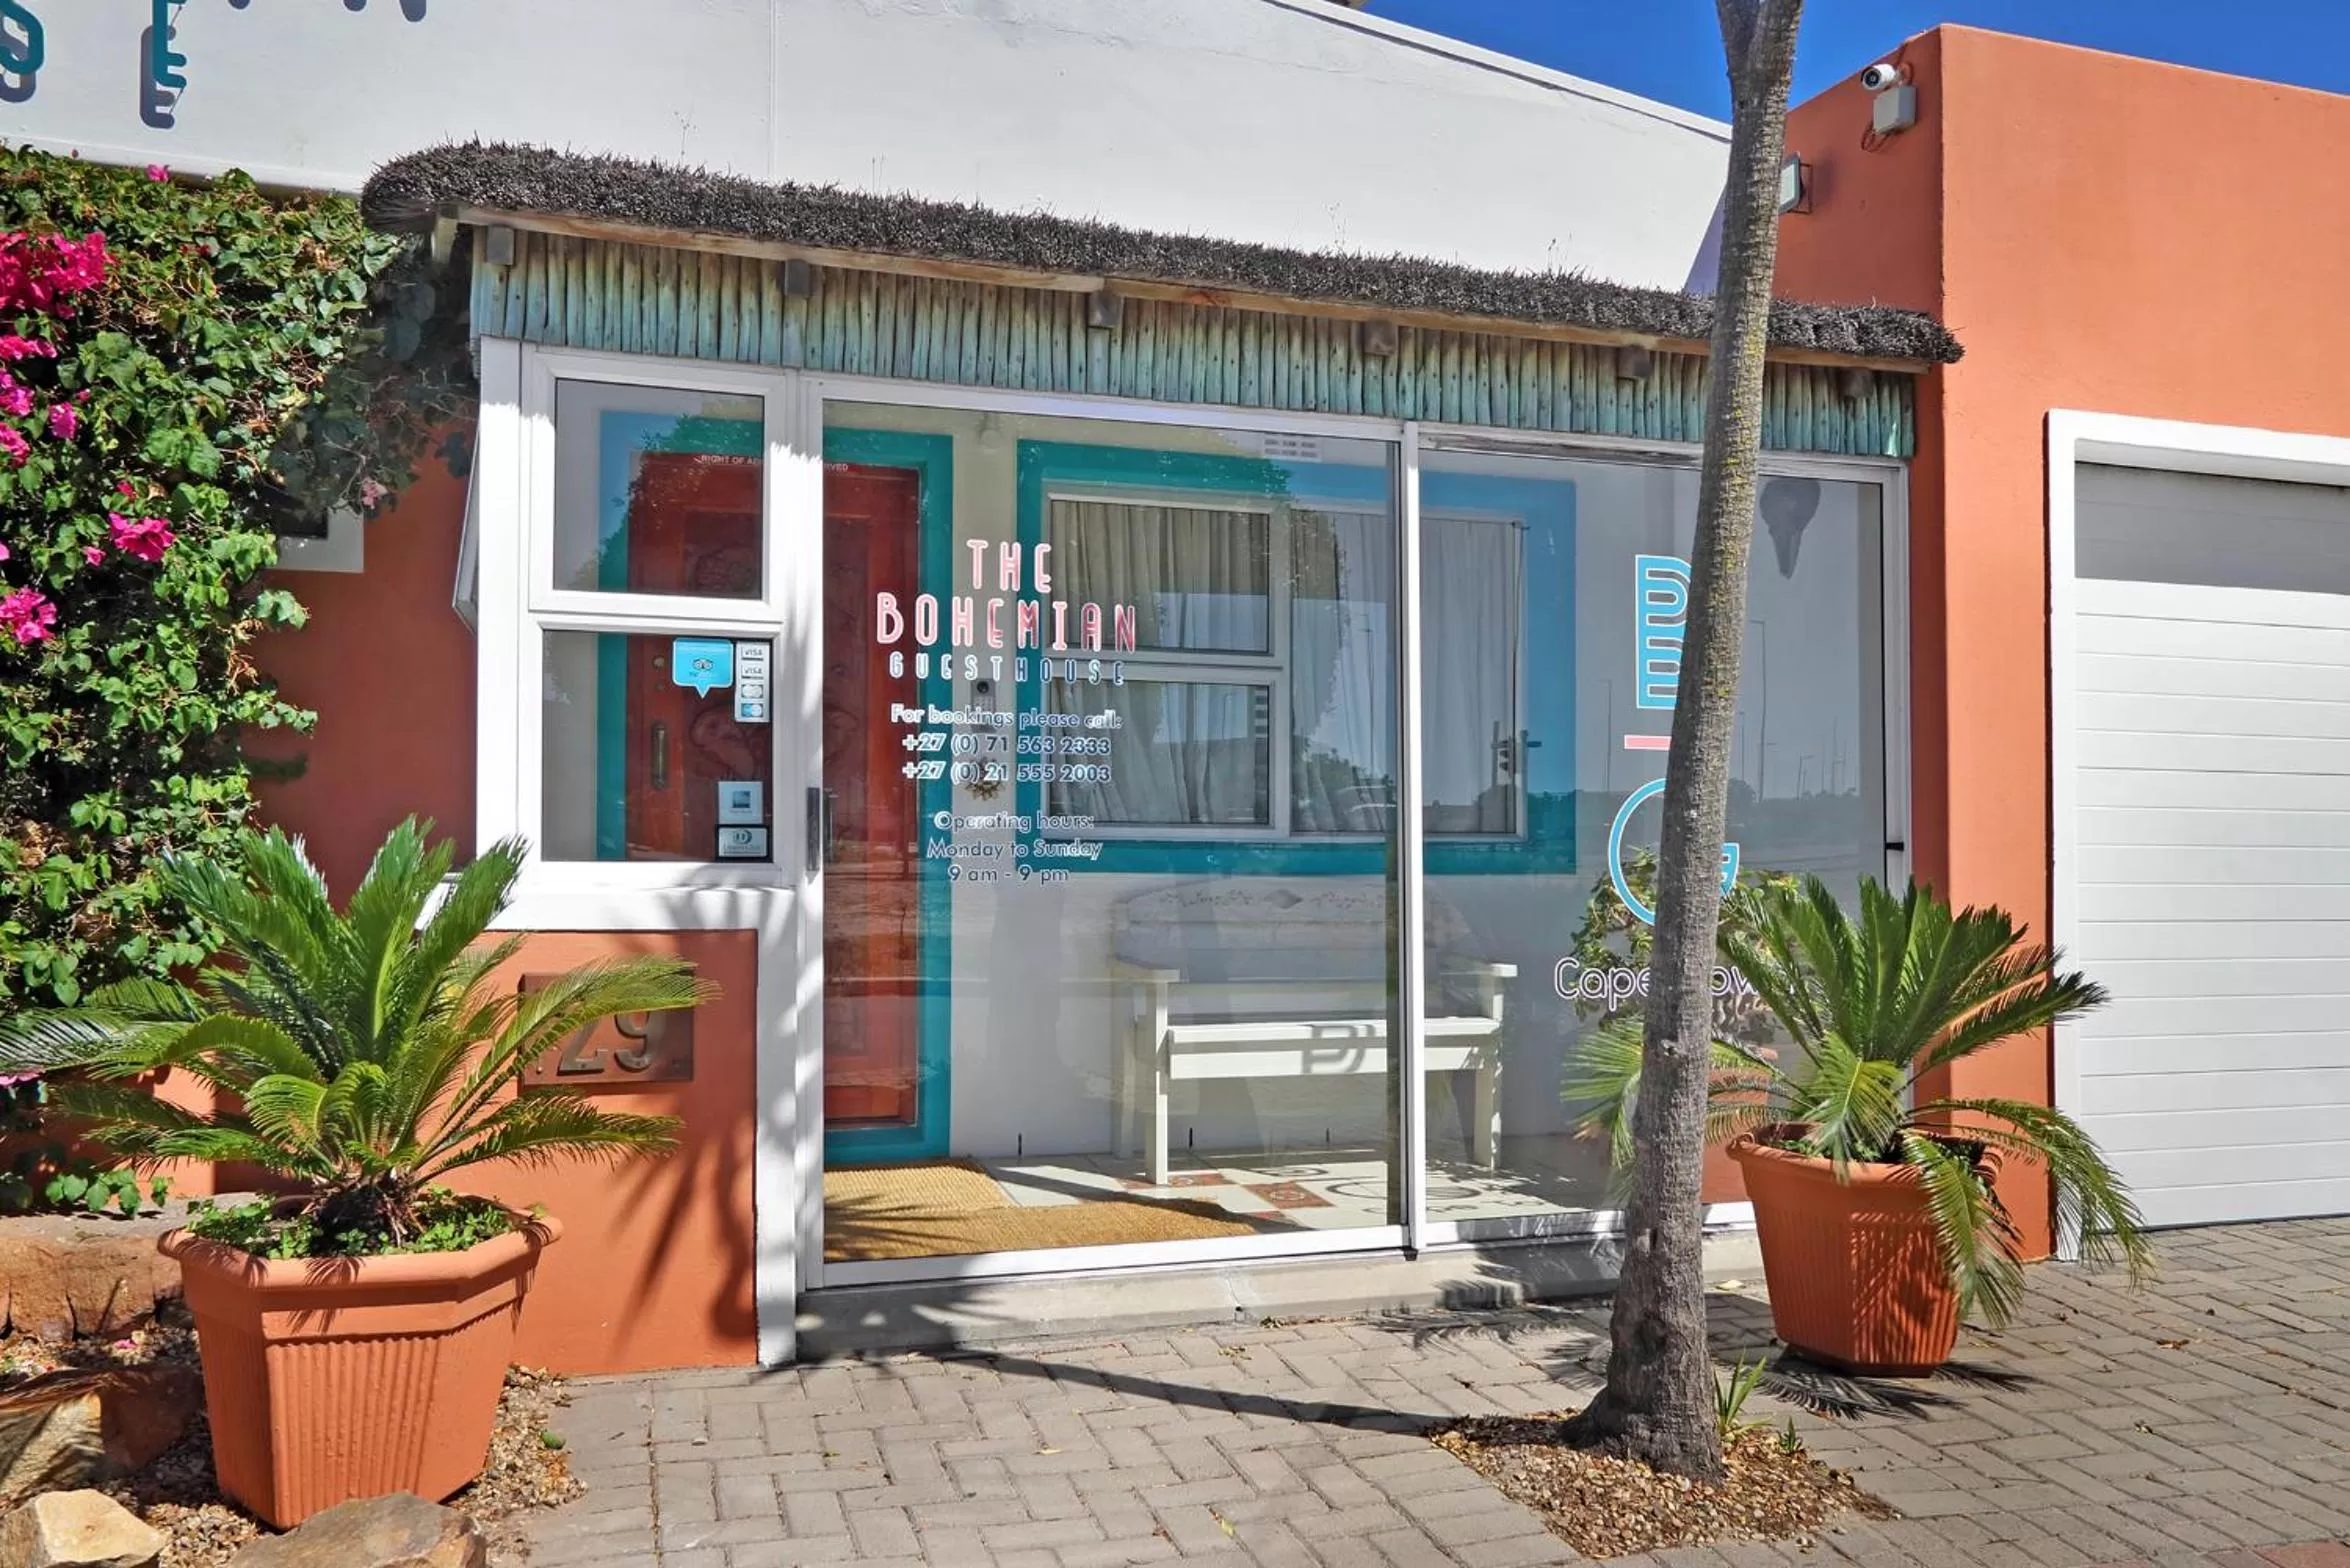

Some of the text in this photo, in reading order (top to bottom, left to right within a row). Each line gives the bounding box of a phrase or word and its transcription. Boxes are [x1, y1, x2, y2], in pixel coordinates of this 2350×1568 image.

[966, 539, 1052, 594] THE
[876, 592, 1137, 654] BOHEMIAN
[888, 652, 1125, 686] GUESTHOUSE
[890, 703, 1123, 730] For bookings please call:
[902, 732, 1111, 755] +27 (0) 71 563 2333
[902, 761, 1111, 784] +27 (0) 21 555 2003
[933, 810, 1094, 833] Operating hours:
[926, 836, 1103, 860] Monday to Sunday
[948, 864, 962, 882] 9
[967, 868, 998, 881] am
[1018, 864, 1032, 882] 9
[1040, 869, 1069, 884] pm
